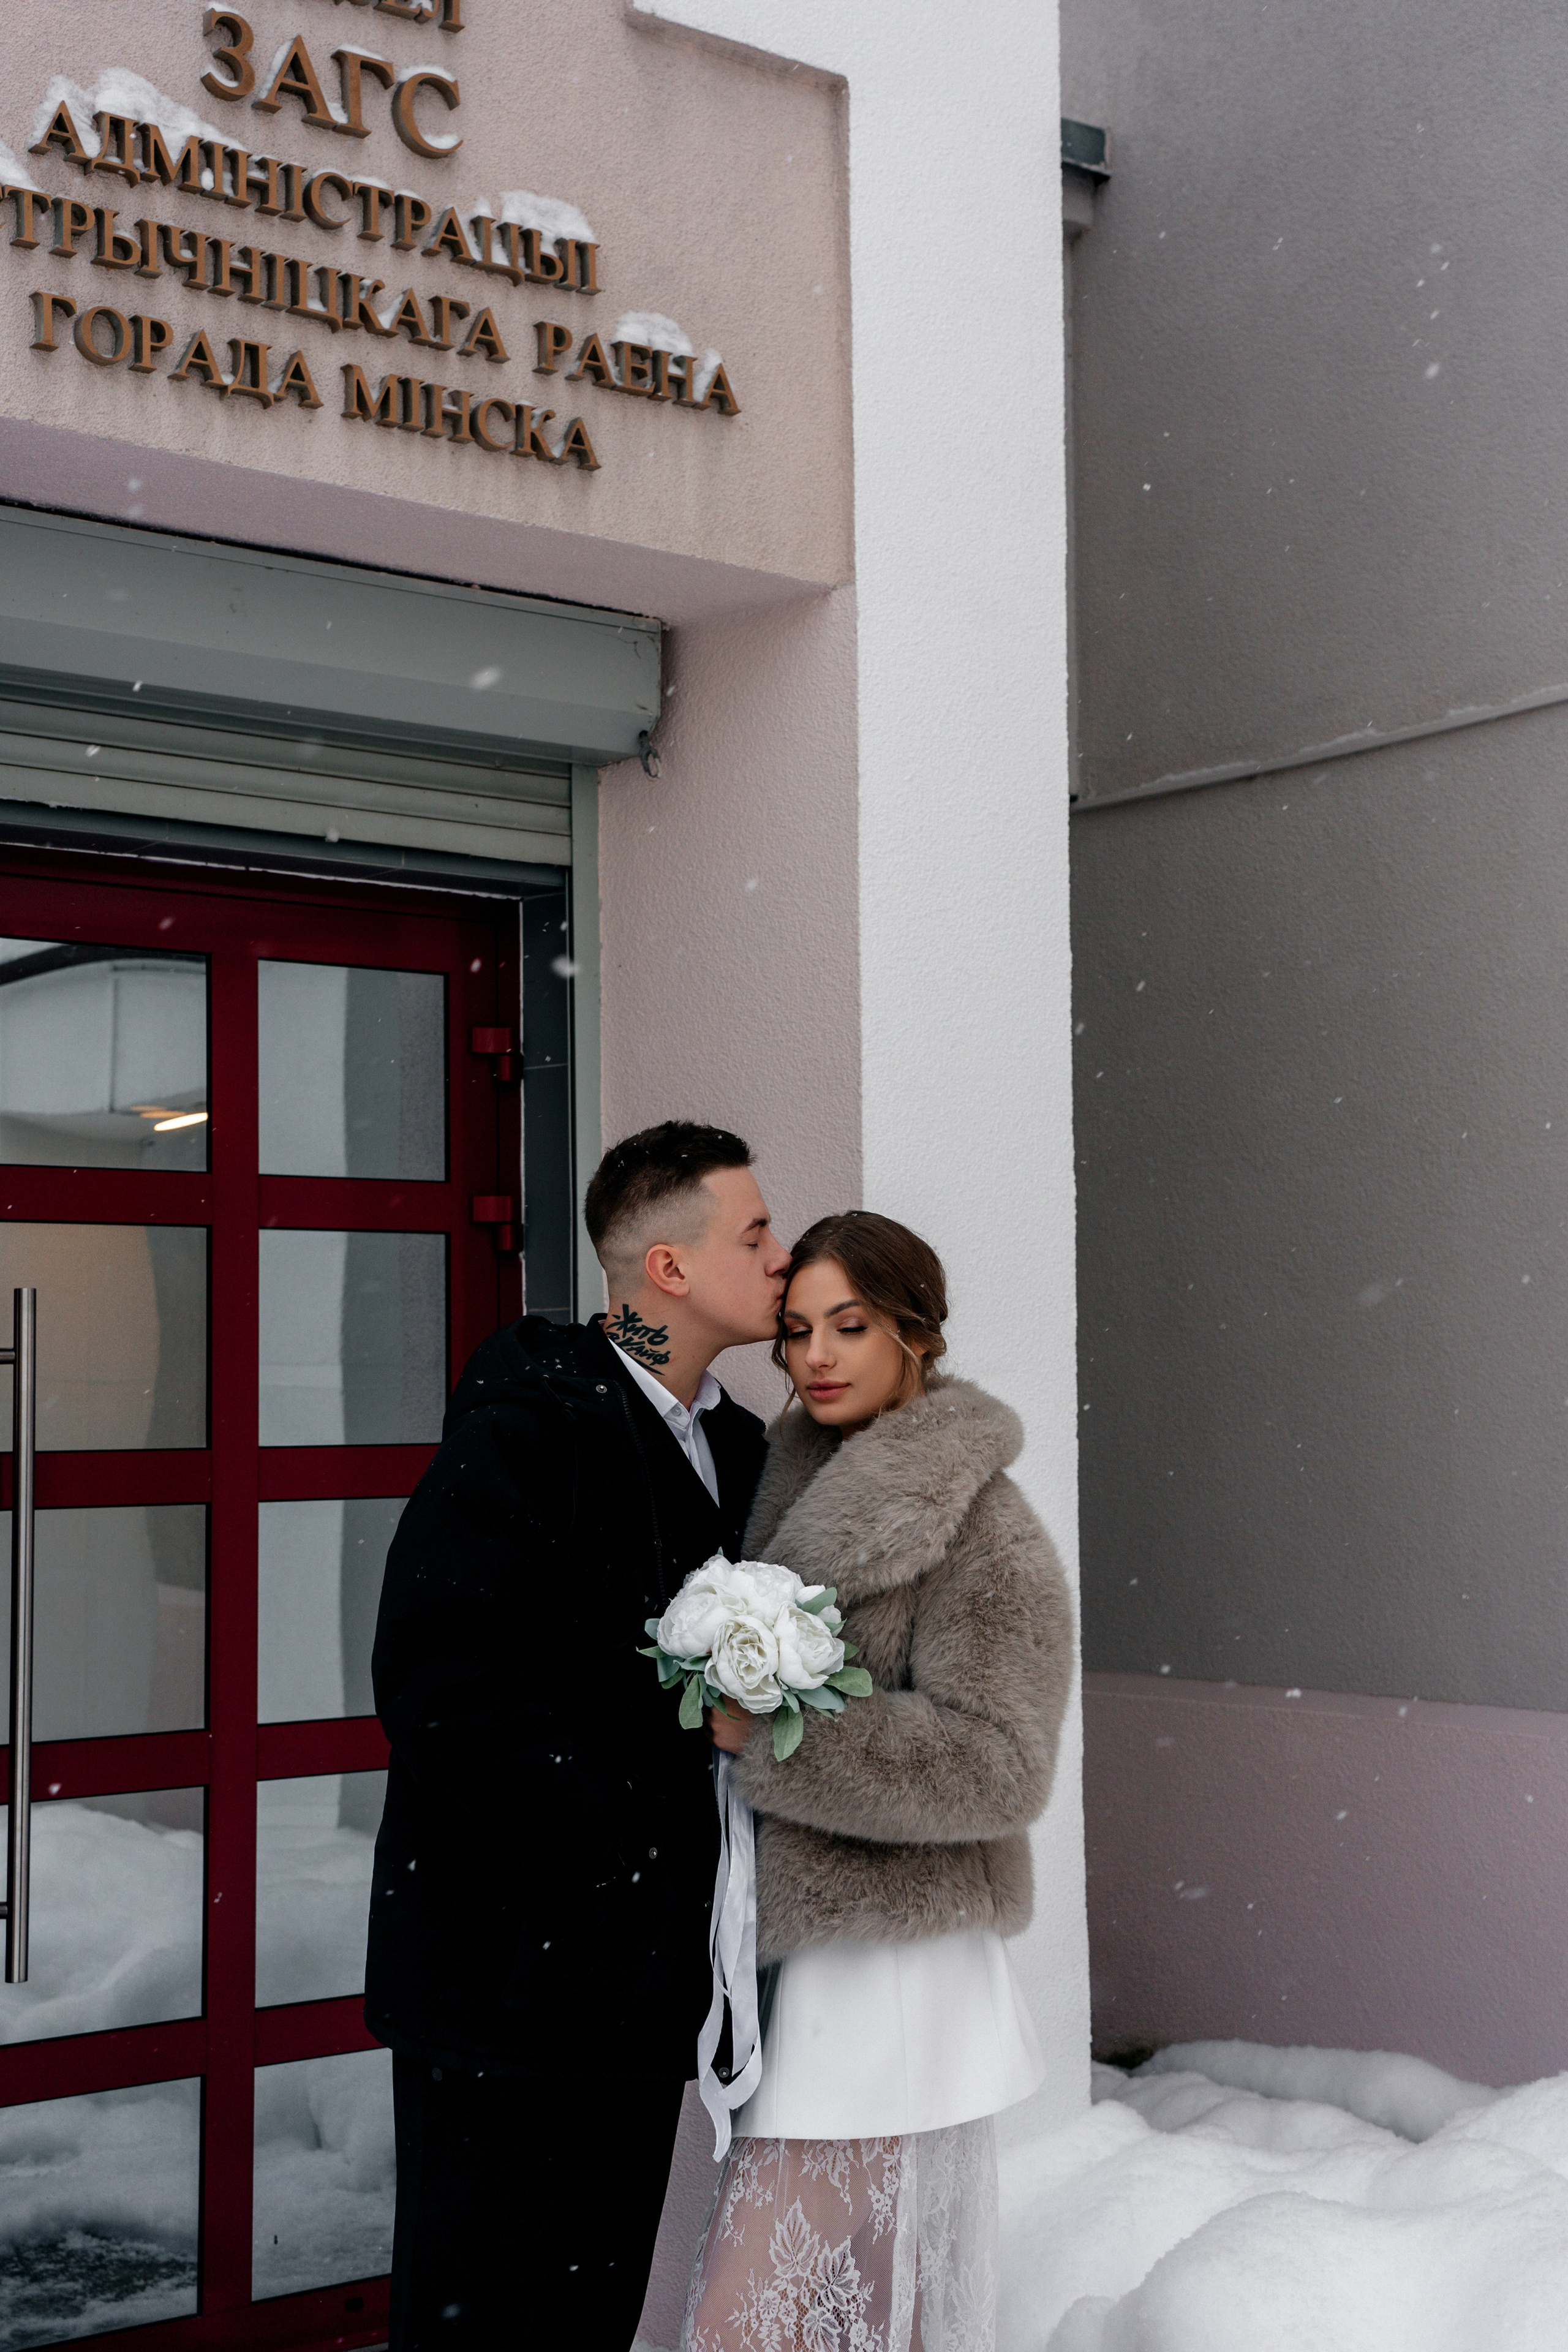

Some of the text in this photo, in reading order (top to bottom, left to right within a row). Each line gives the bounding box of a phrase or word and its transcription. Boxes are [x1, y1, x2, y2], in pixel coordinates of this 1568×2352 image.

[201, 7, 463, 159] ЗАГС
[29, 100, 601, 295] АДМІНІСТРАЦЫІ
[0, 183, 741, 416] ТРЫЧНІЦКАГА РАЕНА
[29, 291, 601, 471] ГОРАДА МІНСКА
